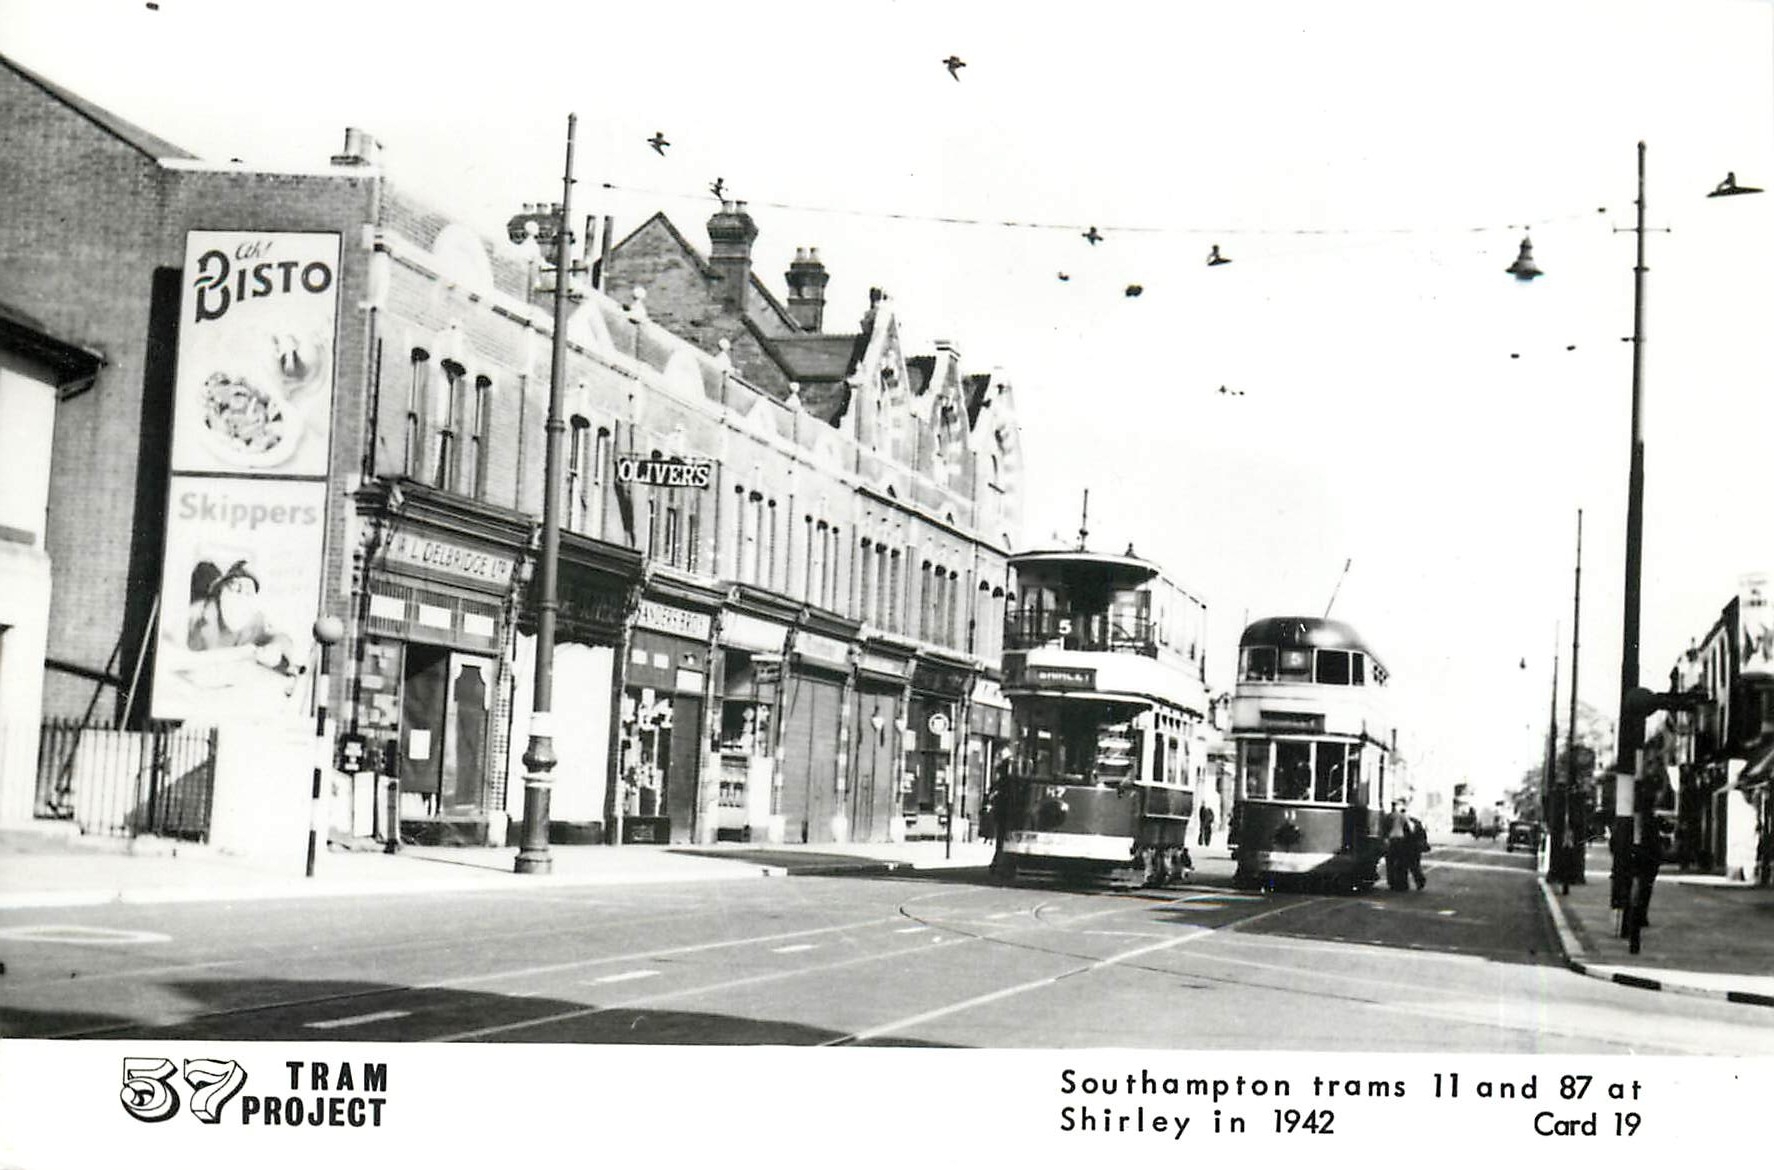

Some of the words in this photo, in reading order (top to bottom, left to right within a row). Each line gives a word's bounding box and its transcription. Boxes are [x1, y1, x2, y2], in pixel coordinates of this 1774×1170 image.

[193, 249, 332, 323] BISTO
[178, 491, 318, 530] Skippers
[422, 542, 489, 575] DELBRIDGE
[1059, 619, 1072, 634] 5
[1284, 809, 1297, 821] 11
